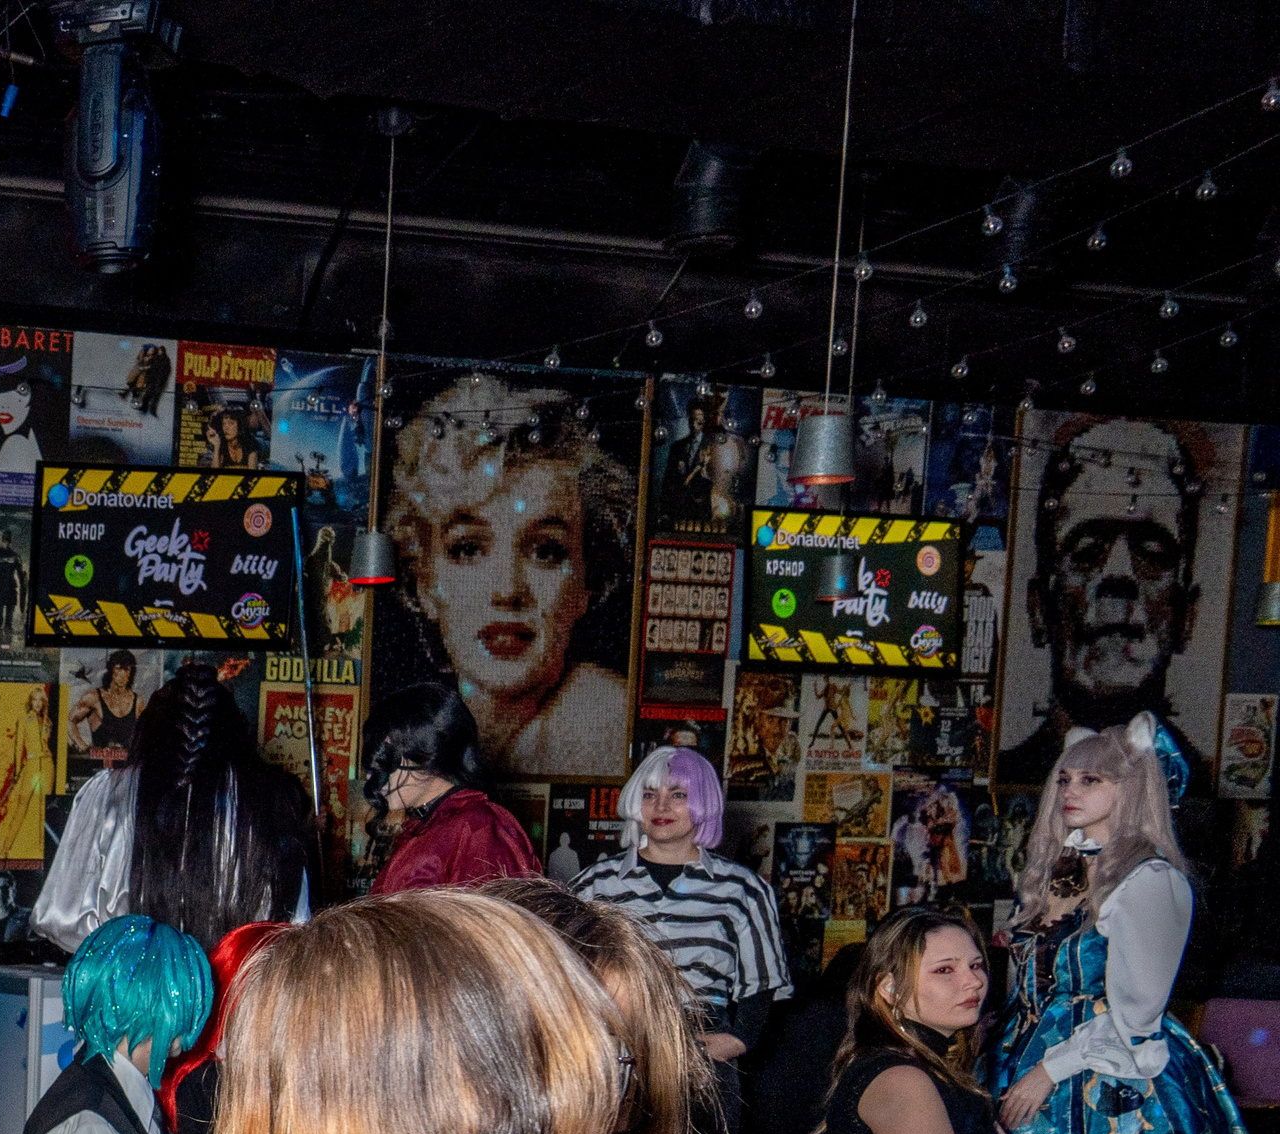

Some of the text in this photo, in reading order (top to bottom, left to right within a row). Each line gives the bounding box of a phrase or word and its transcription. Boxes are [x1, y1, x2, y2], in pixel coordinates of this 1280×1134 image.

[183, 351, 275, 383] PULP FICTION
[72, 487, 174, 510] Donatov.net
[58, 522, 105, 541] KPSHOP
[124, 516, 190, 558] Geek
[777, 529, 861, 551] Donatov.net
[137, 544, 207, 596] Party
[766, 559, 805, 577] KPSHOP
[589, 786, 621, 819] LEO
